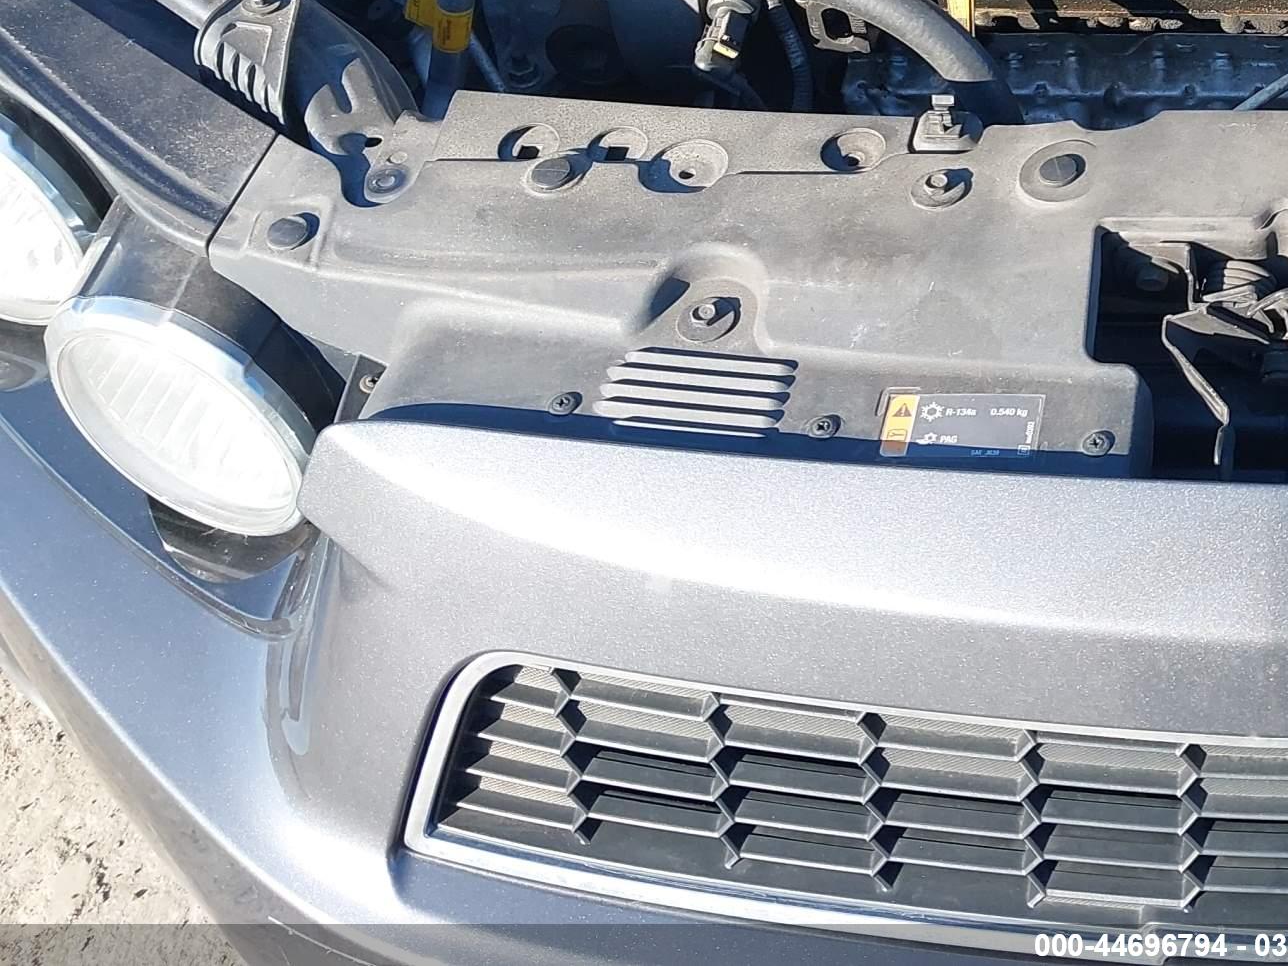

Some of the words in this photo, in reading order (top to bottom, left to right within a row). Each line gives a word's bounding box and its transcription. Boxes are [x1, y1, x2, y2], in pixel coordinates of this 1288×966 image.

[945, 407, 977, 418] R-134a
[990, 407, 1016, 418] 0.540
[1016, 408, 1028, 419] kg
[939, 435, 958, 445] PAG
